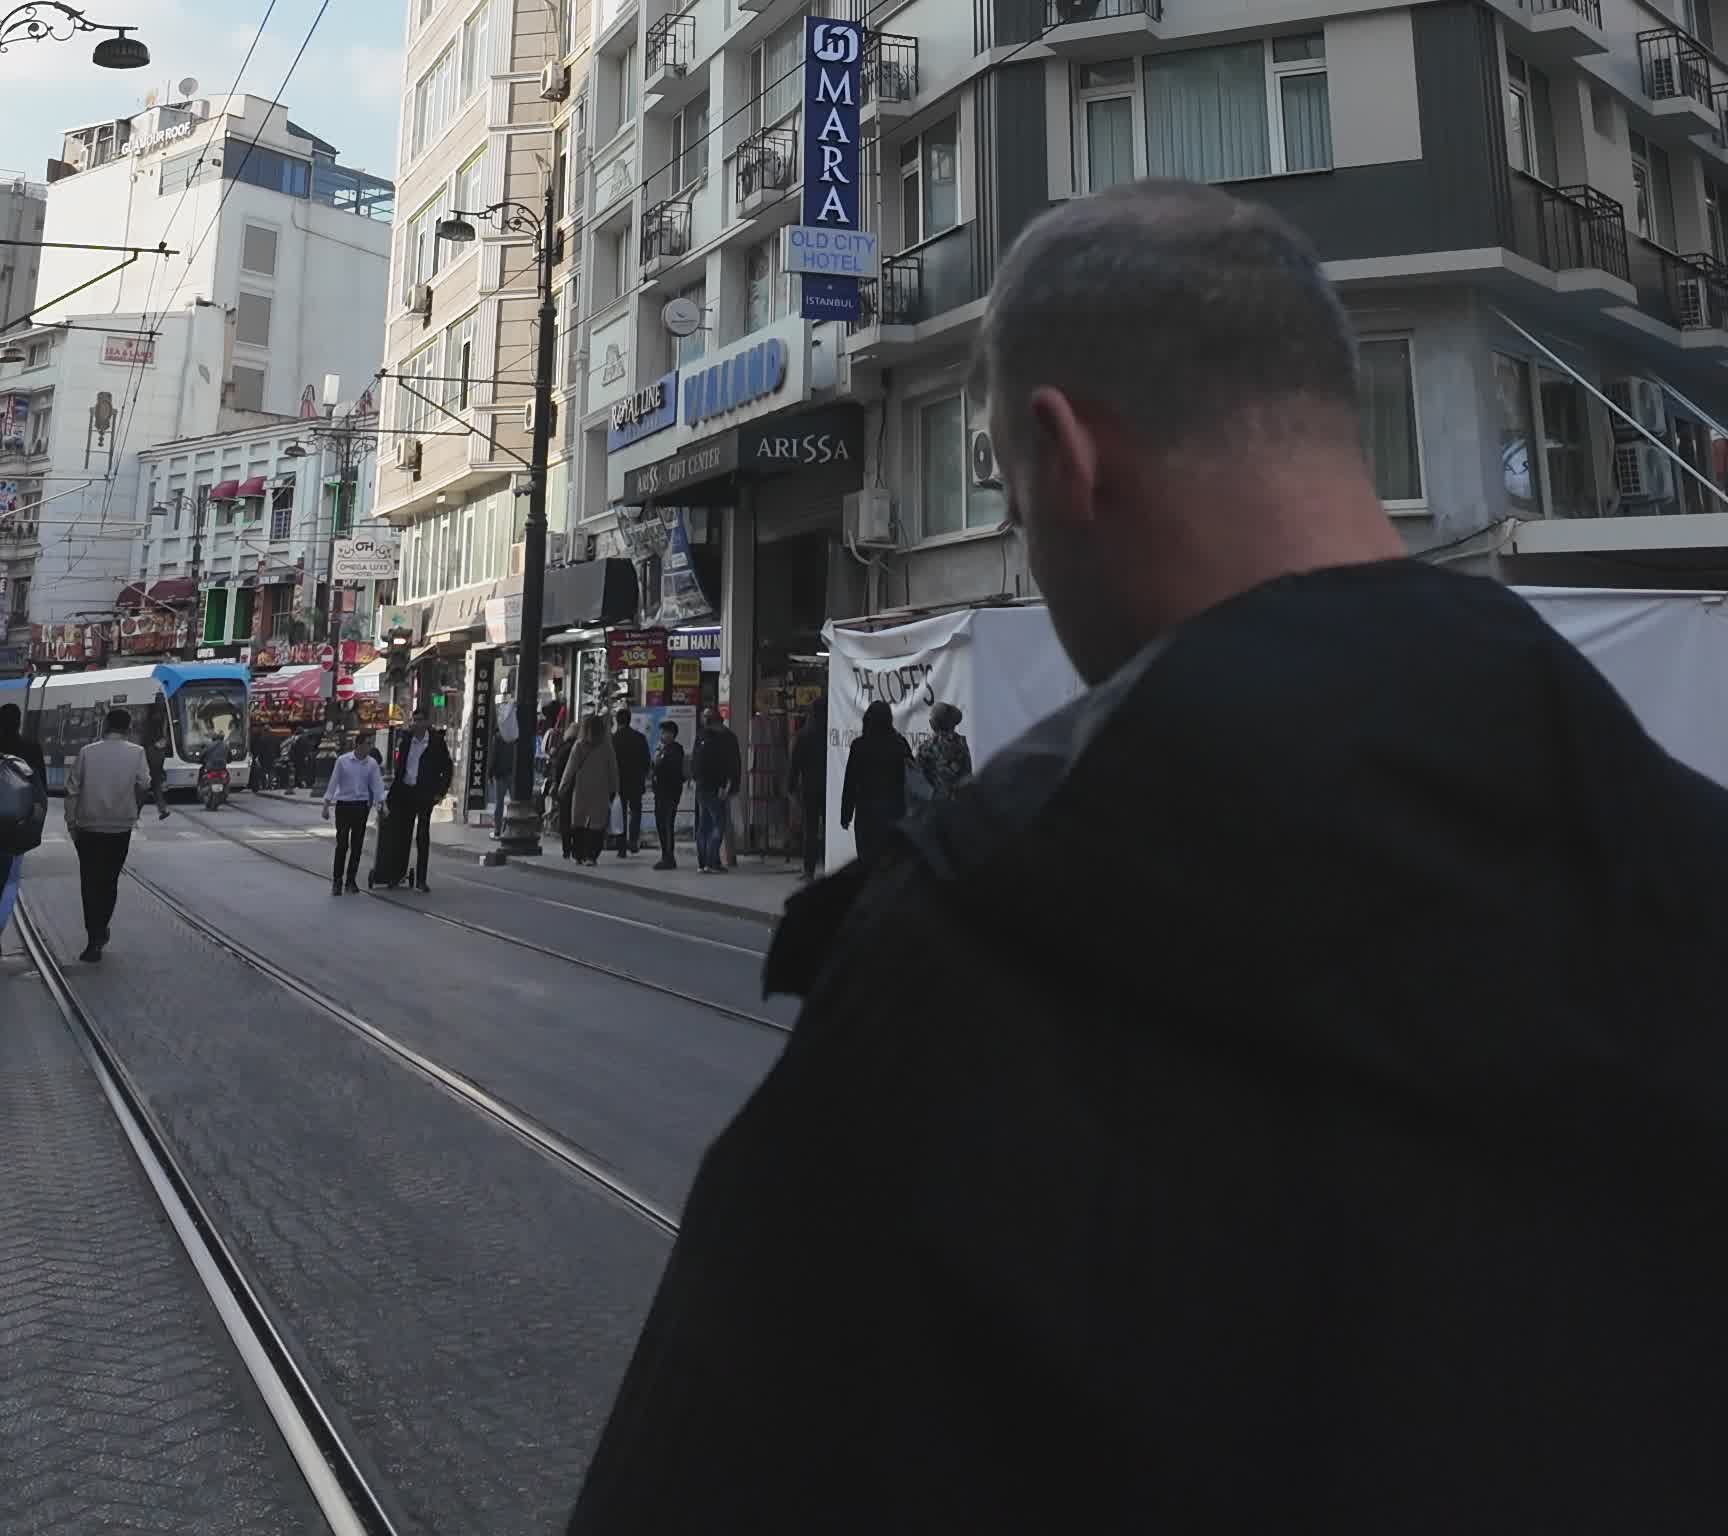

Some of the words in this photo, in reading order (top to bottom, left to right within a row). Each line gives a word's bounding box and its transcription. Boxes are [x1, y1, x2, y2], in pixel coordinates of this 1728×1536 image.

[165, 121, 191, 140] ROOF
[815, 66, 854, 223] MARA
[791, 230, 828, 249] OLD
[834, 233, 876, 254] CITY
[802, 251, 863, 273] HOTEL
[611, 393, 640, 431] ROYAL
[641, 384, 661, 413] LINE
[756, 434, 849, 463] ARISSA
[667, 635, 688, 651] CEM
[690, 634, 711, 650] HAN
